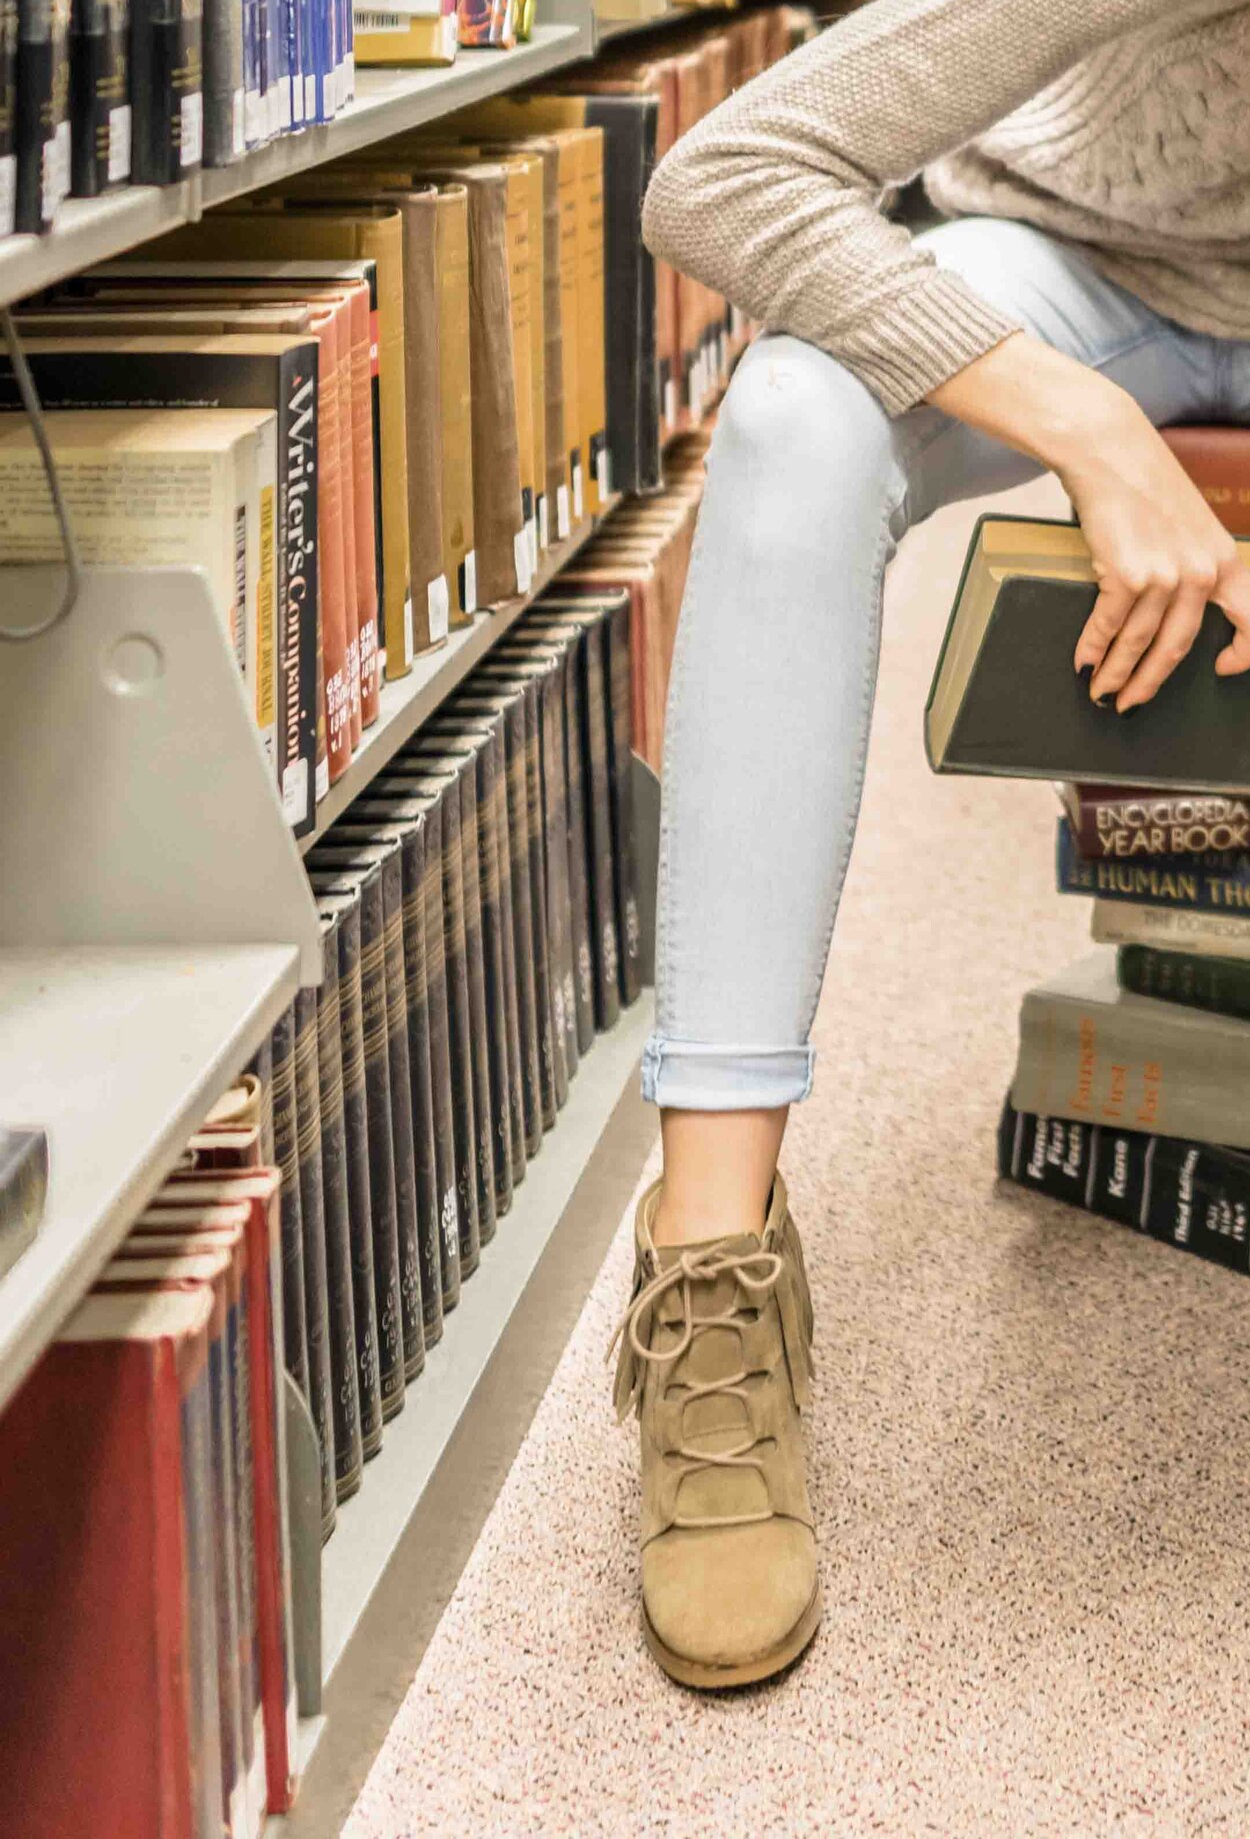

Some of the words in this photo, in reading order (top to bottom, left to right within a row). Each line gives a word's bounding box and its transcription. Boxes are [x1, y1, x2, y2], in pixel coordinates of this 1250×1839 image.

[287, 378, 314, 576] Writer's
[261, 498, 273, 529] THE
[261, 536, 273, 581] WALL
[262, 585, 273, 642] STREET
[262, 647, 273, 718] JOURNAL
[282, 576, 307, 764] Companion
[1096, 799, 1250, 829] ENCYCLOPEDIA
[1098, 828, 1165, 857] YEAR
[1170, 823, 1250, 852] BOOK
[1098, 867, 1198, 902] HUMAN
[1143, 909, 1175, 929] THE
[1068, 1016, 1097, 1113] Famous
[1046, 1121, 1065, 1166] First
[1062, 1124, 1083, 1179] Facts
[1107, 1139, 1129, 1198] Kane
[1178, 1149, 1200, 1203] Edition
[1174, 1202, 1192, 1243] Third
